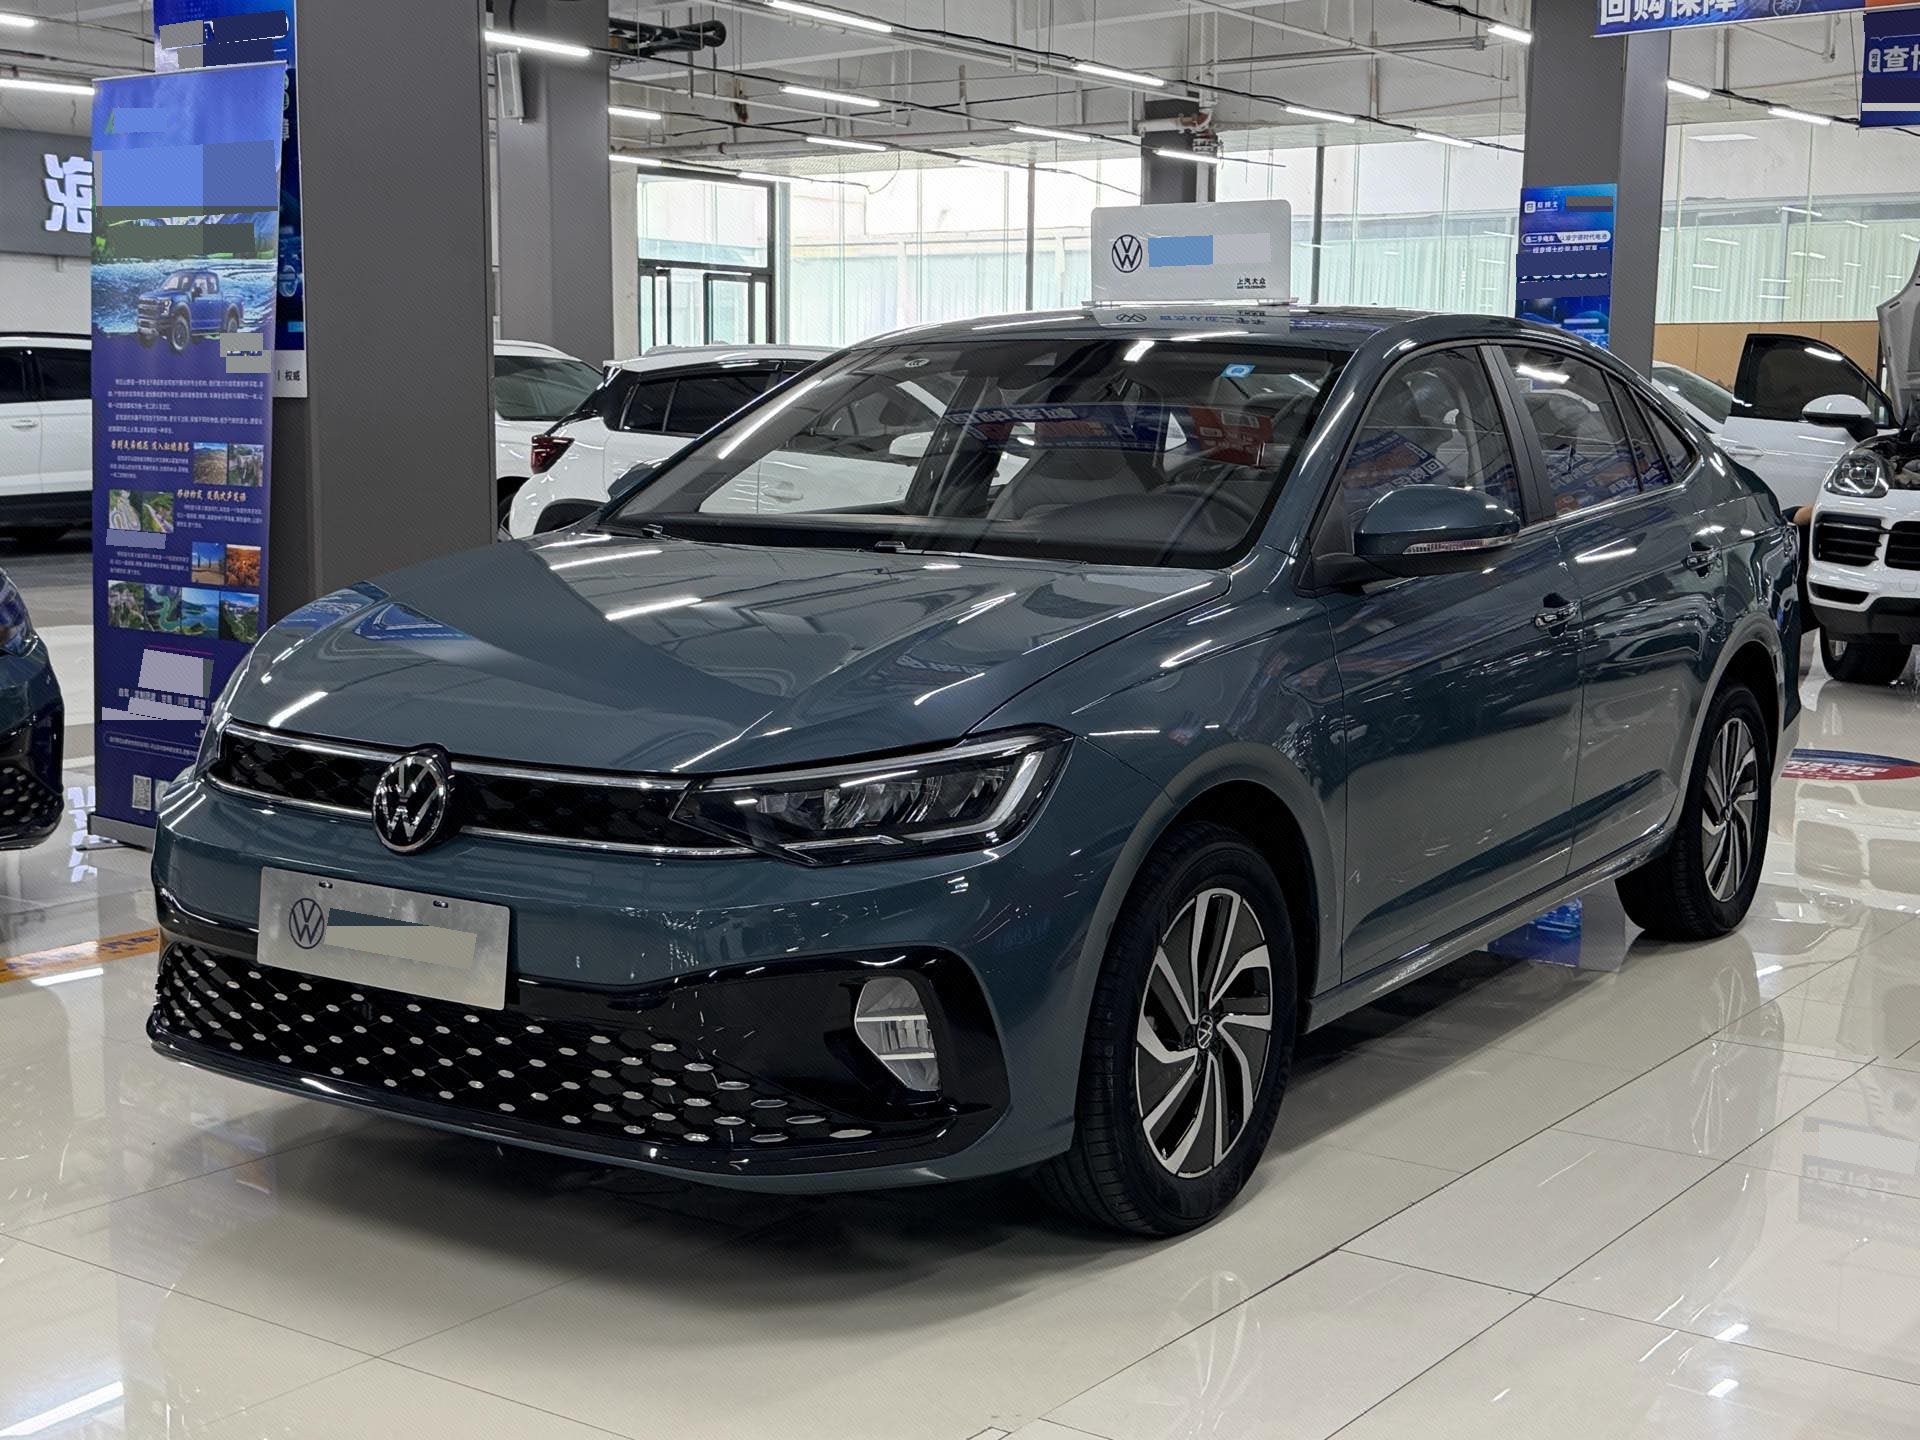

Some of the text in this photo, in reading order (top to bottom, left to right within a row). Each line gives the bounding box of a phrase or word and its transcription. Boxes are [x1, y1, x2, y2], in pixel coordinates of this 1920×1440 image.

[1112, 234, 1143, 273] VW
[1236, 277, 1266, 285] 上汽大众
[373, 752, 448, 853] VW
[289, 898, 325, 949] VW
